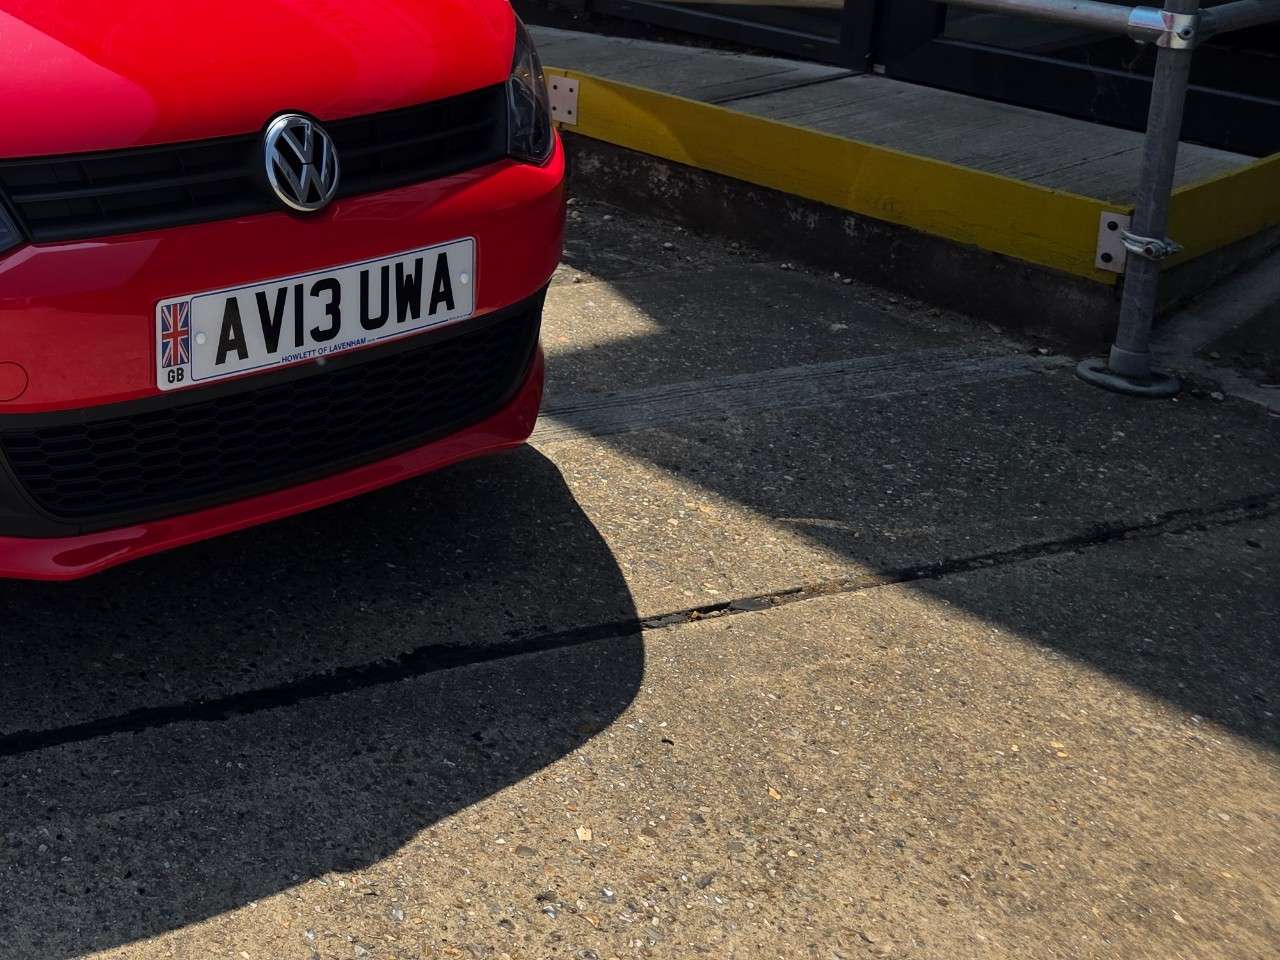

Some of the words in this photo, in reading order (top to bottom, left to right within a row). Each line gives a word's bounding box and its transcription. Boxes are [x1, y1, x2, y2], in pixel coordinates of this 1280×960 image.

[215, 277, 342, 366] AV13
[359, 252, 456, 331] UWA
[281, 349, 316, 363] HOWLETT
[317, 347, 328, 355] OF
[329, 337, 367, 352] LAVENHAM
[167, 367, 185, 385] GB
